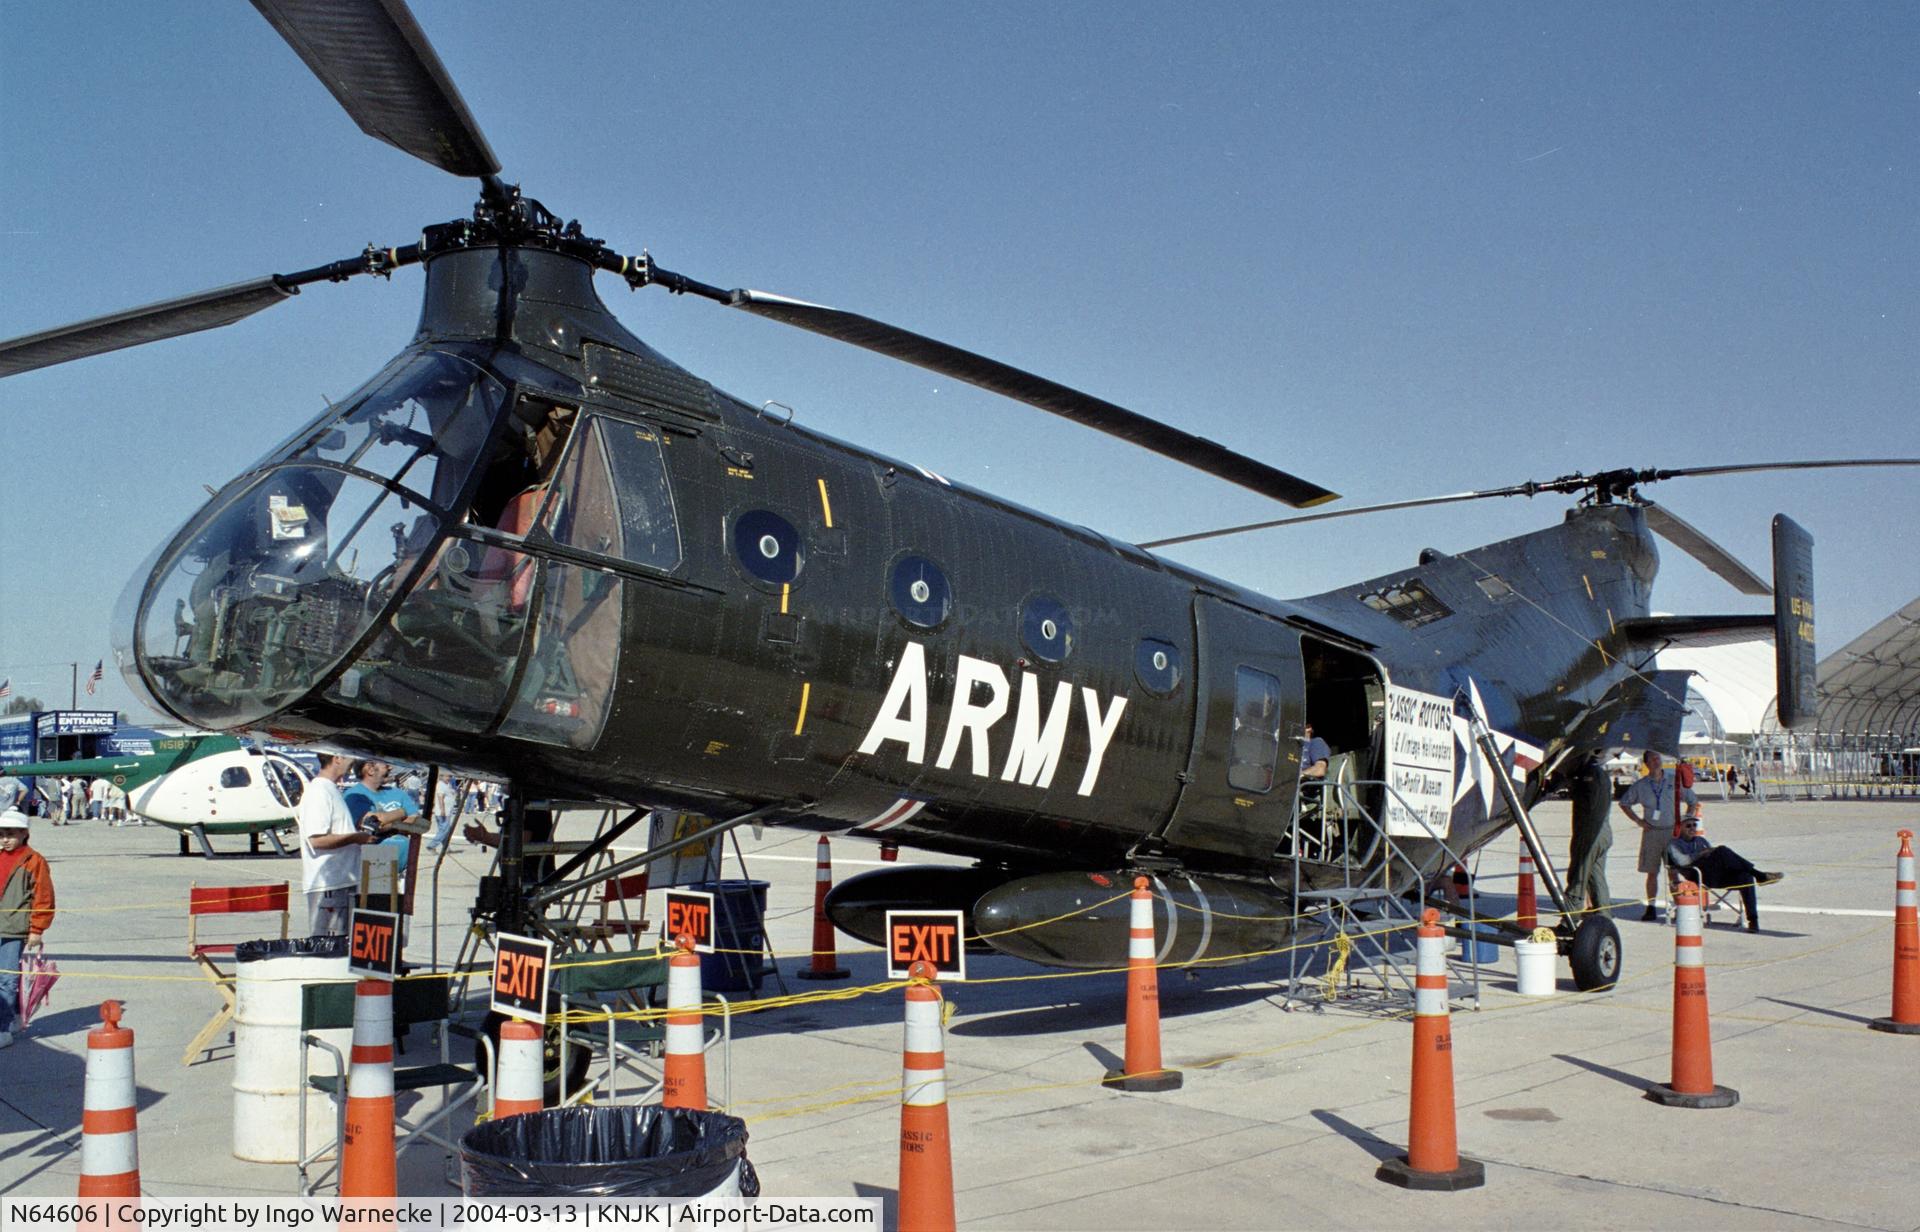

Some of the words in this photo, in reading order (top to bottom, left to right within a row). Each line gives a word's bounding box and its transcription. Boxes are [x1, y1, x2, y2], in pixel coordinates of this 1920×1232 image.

[58, 717, 114, 725] ENTRANCE
[857, 641, 1128, 797] ARMY
[1418, 701, 1452, 732] ROTORS
[669, 902, 709, 937] EXIT
[352, 922, 393, 962] EXIT
[893, 925, 955, 962] EXIT
[496, 949, 544, 1000] EXIT
